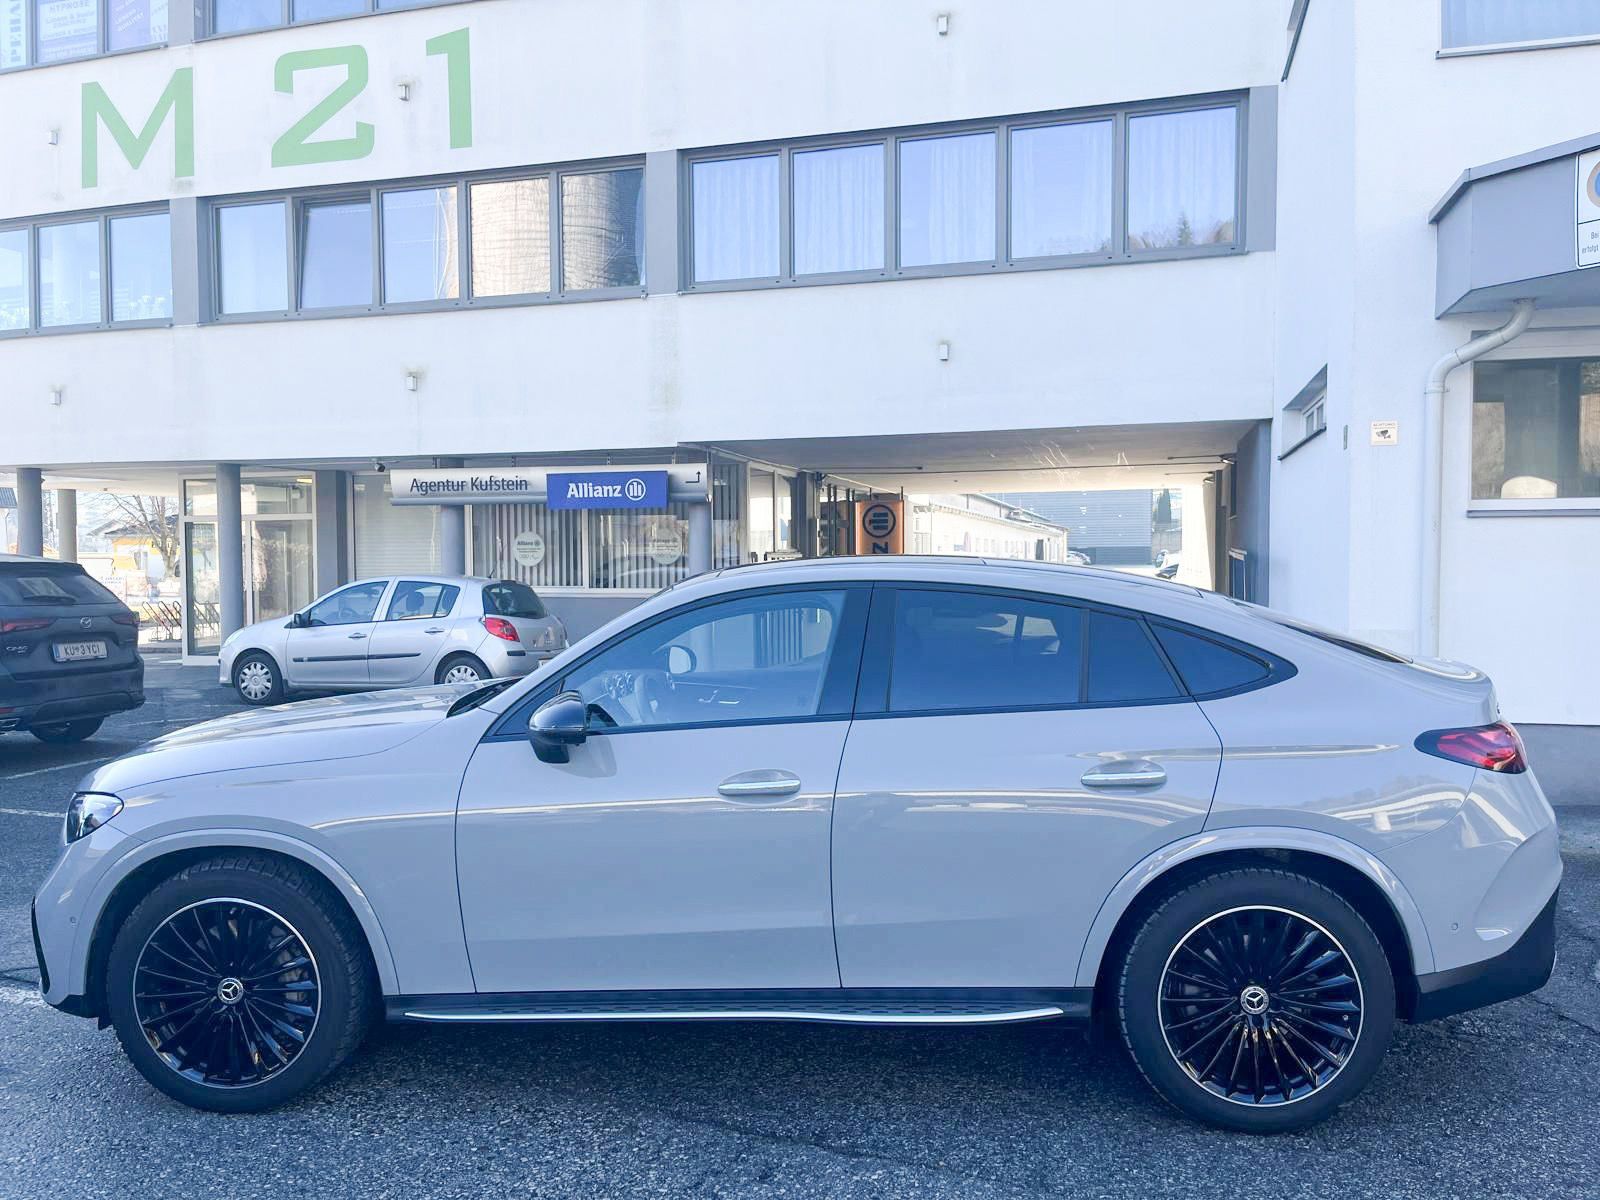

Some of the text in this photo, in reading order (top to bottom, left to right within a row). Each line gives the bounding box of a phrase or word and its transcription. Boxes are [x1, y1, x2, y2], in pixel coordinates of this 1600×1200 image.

[81, 27, 473, 189] M 21
[410, 475, 528, 496] Agentur Kufstein
[566, 482, 622, 499] Allianz
